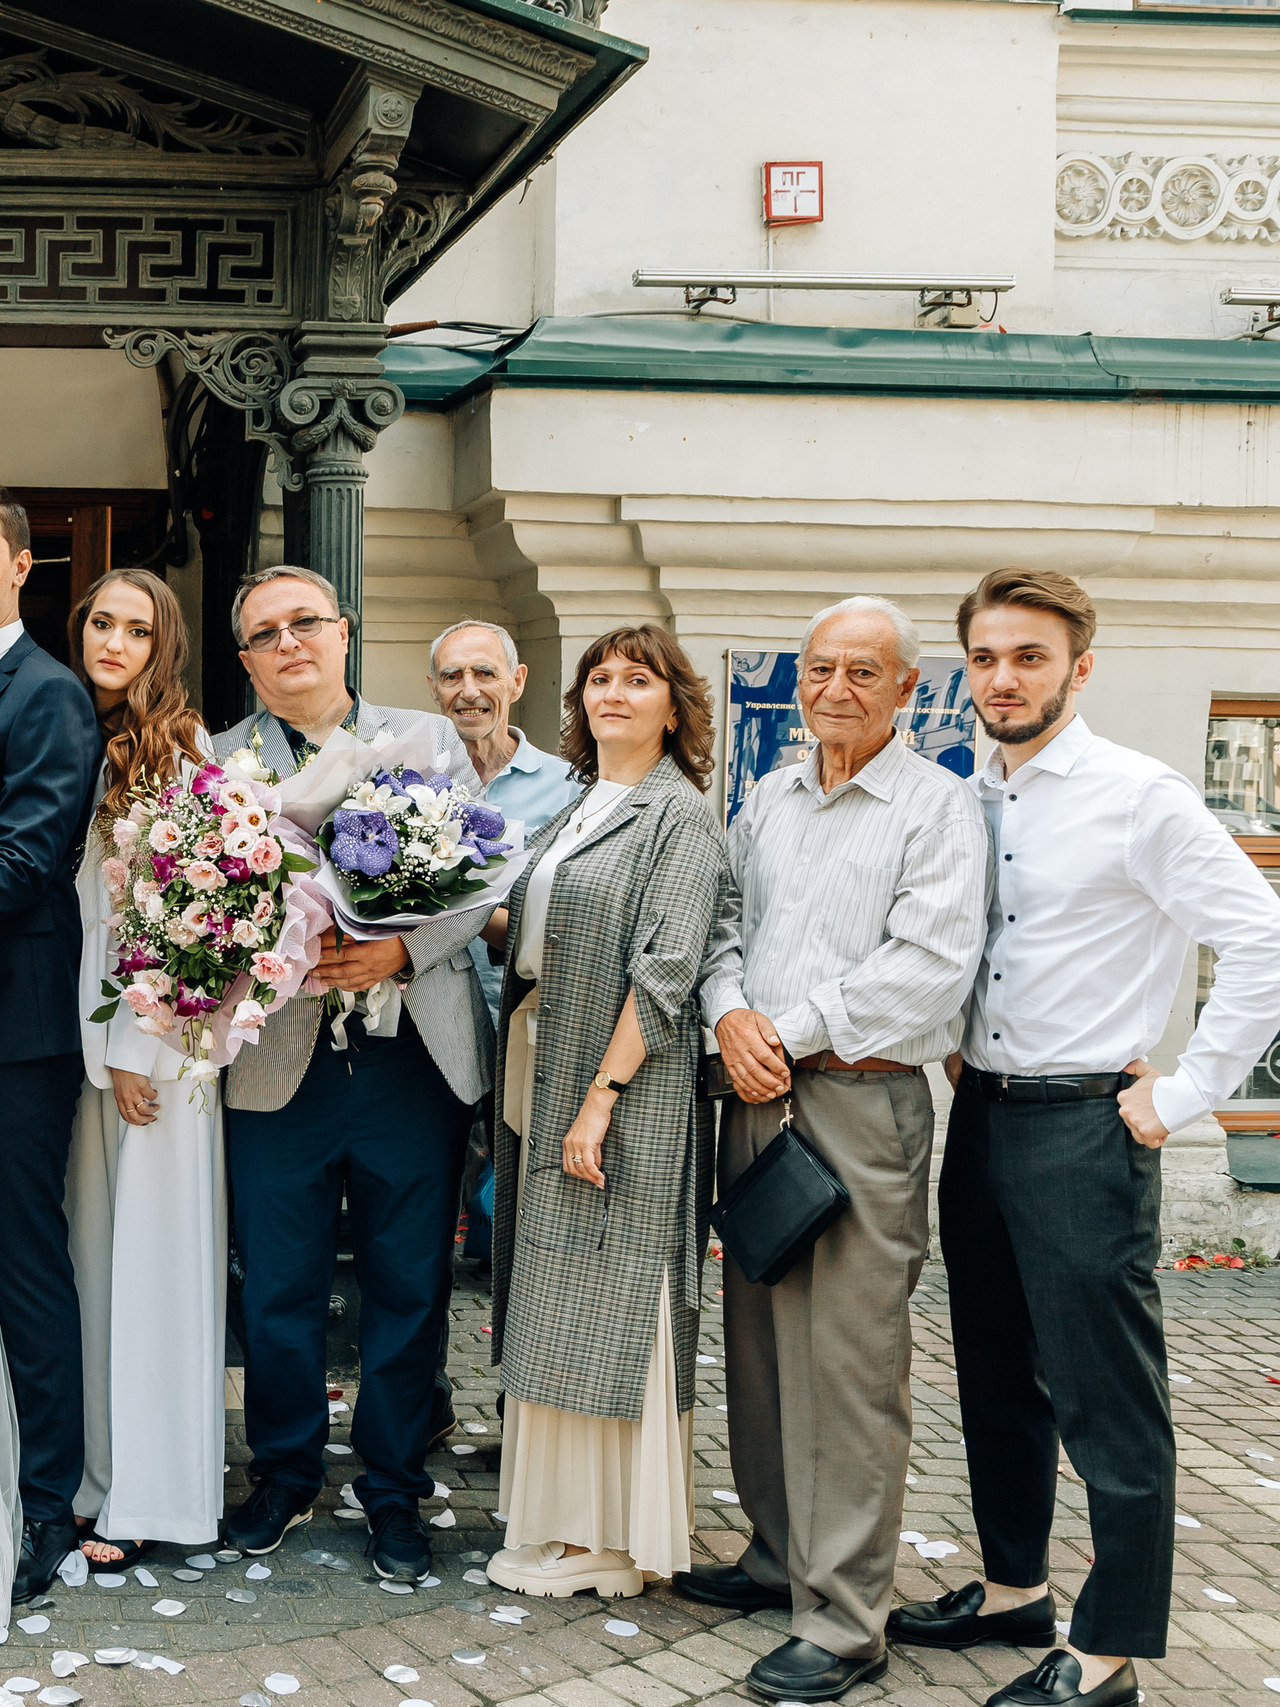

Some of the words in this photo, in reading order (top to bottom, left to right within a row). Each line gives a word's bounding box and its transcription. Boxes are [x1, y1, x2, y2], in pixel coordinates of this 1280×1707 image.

[782, 171, 806, 186] ПГ
[745, 701, 796, 710] Управление
[917, 707, 961, 715] состояния
